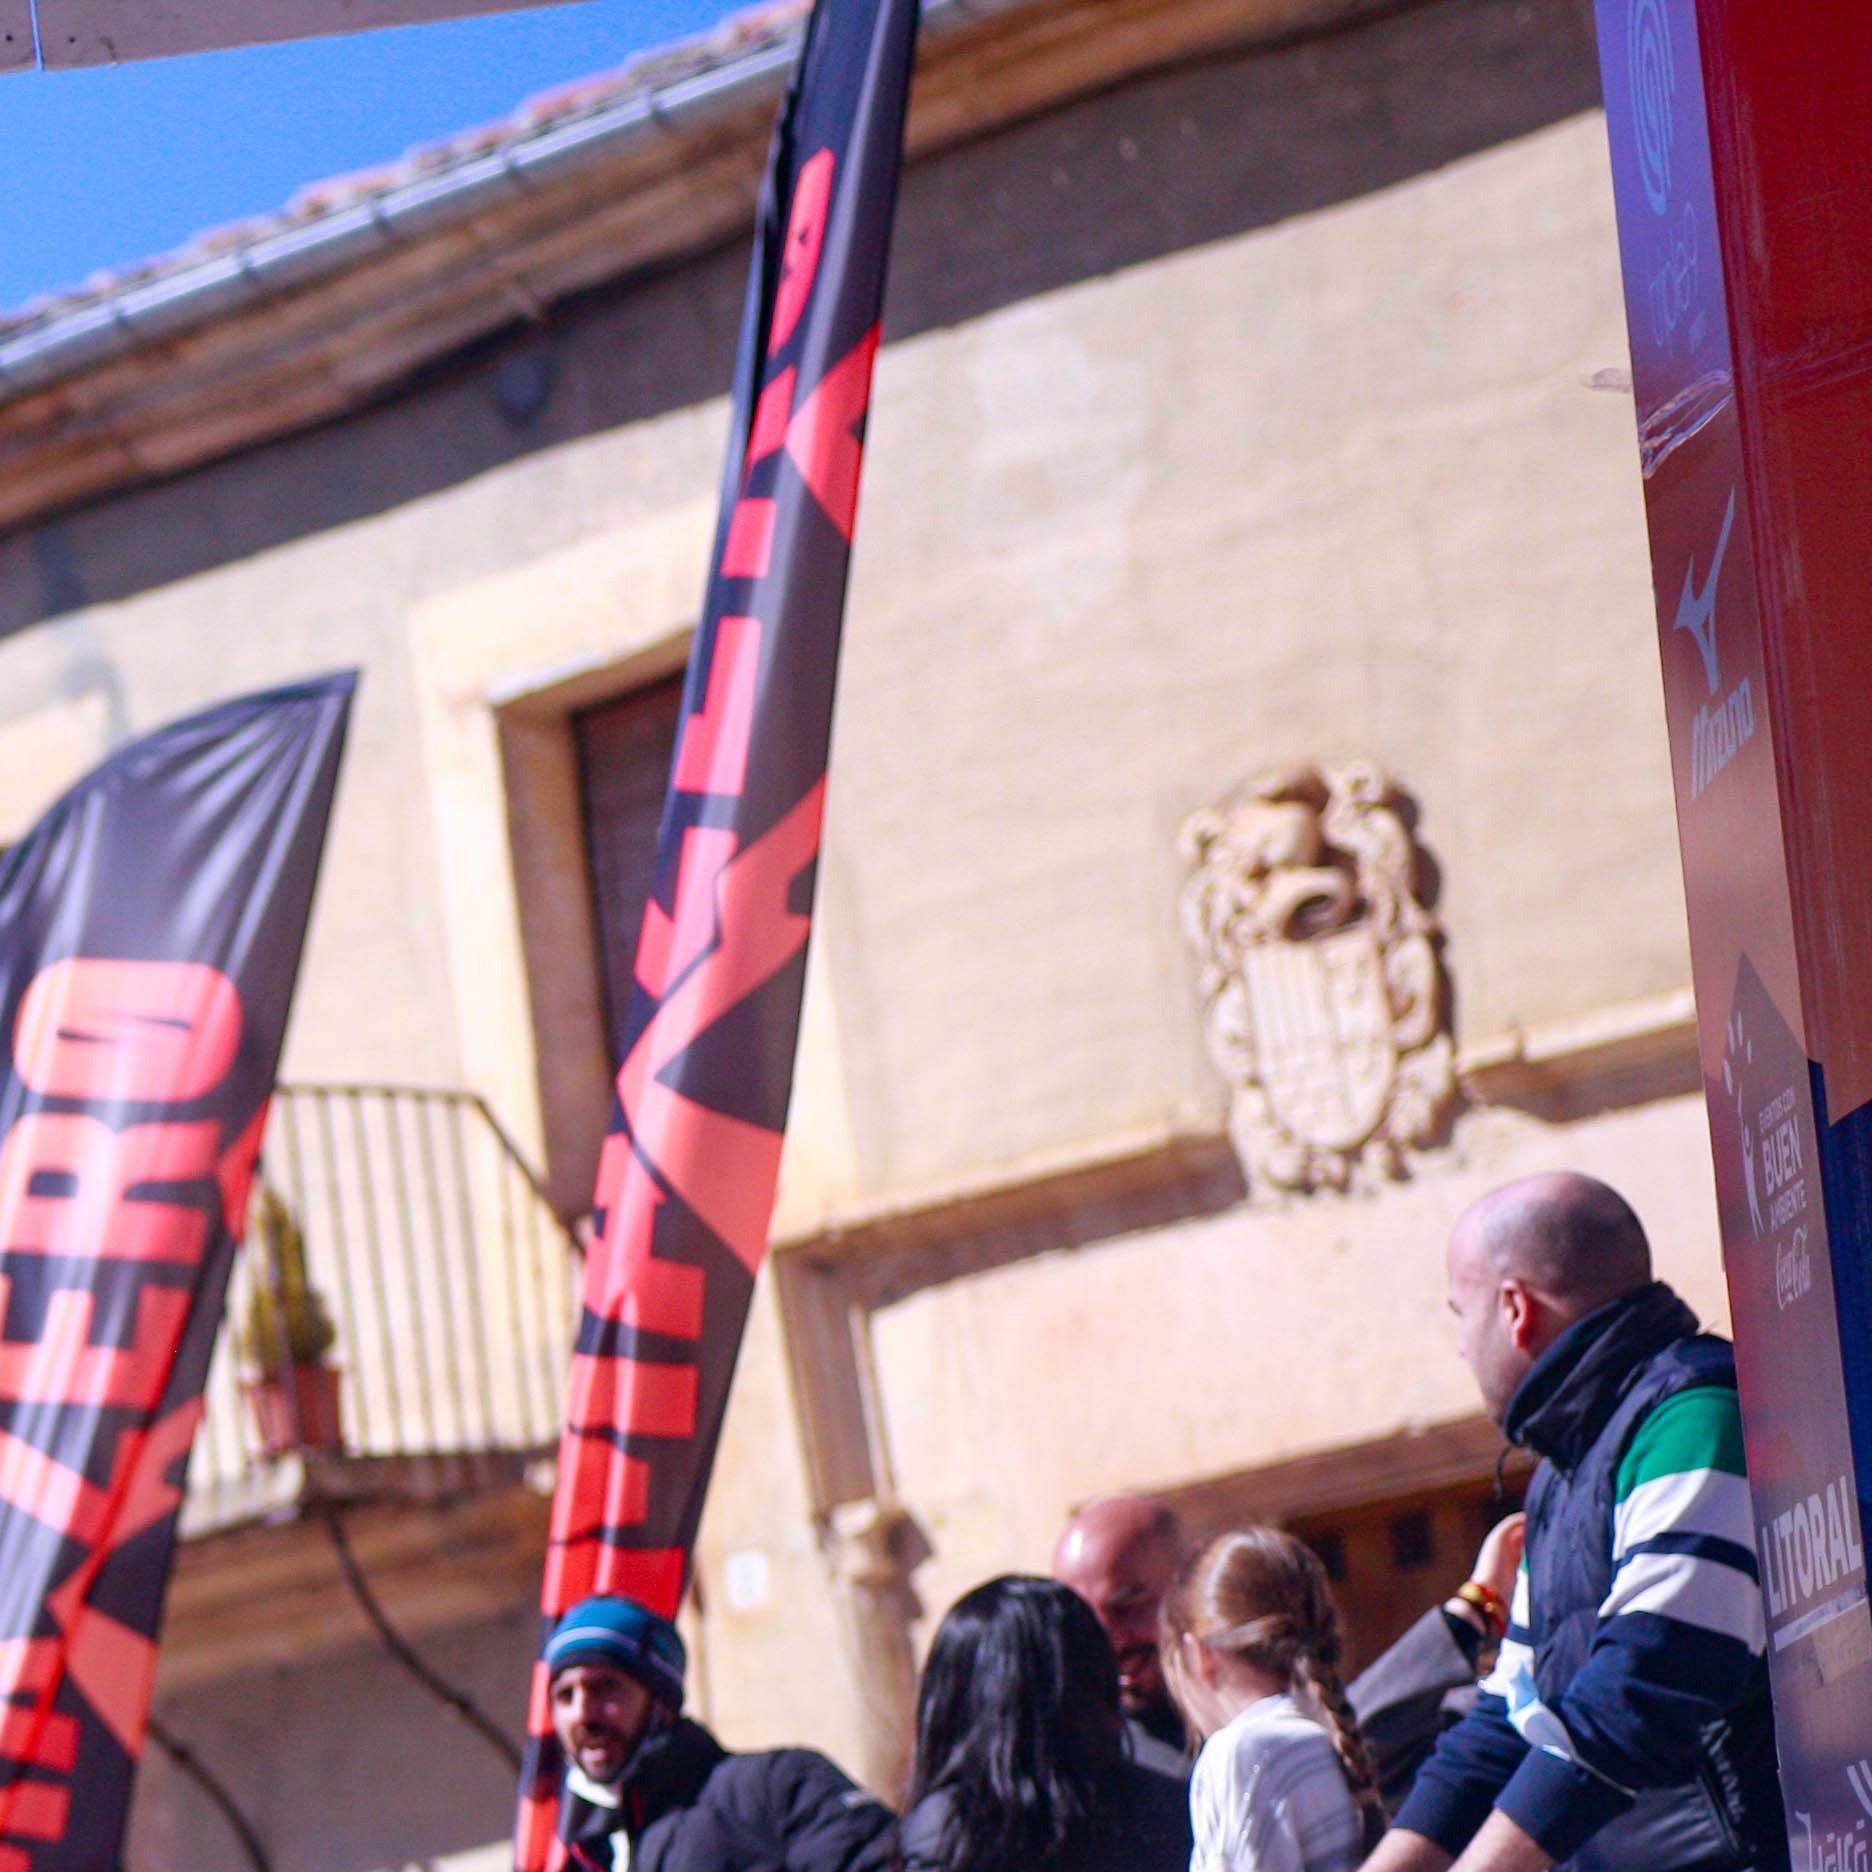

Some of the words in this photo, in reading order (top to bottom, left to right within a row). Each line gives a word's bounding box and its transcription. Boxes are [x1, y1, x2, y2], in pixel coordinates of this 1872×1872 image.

[1762, 1115, 1803, 1197] BUEN
[1770, 1179, 1807, 1233] AMBIENTE
[1762, 1476, 1863, 1618] LITORAL
